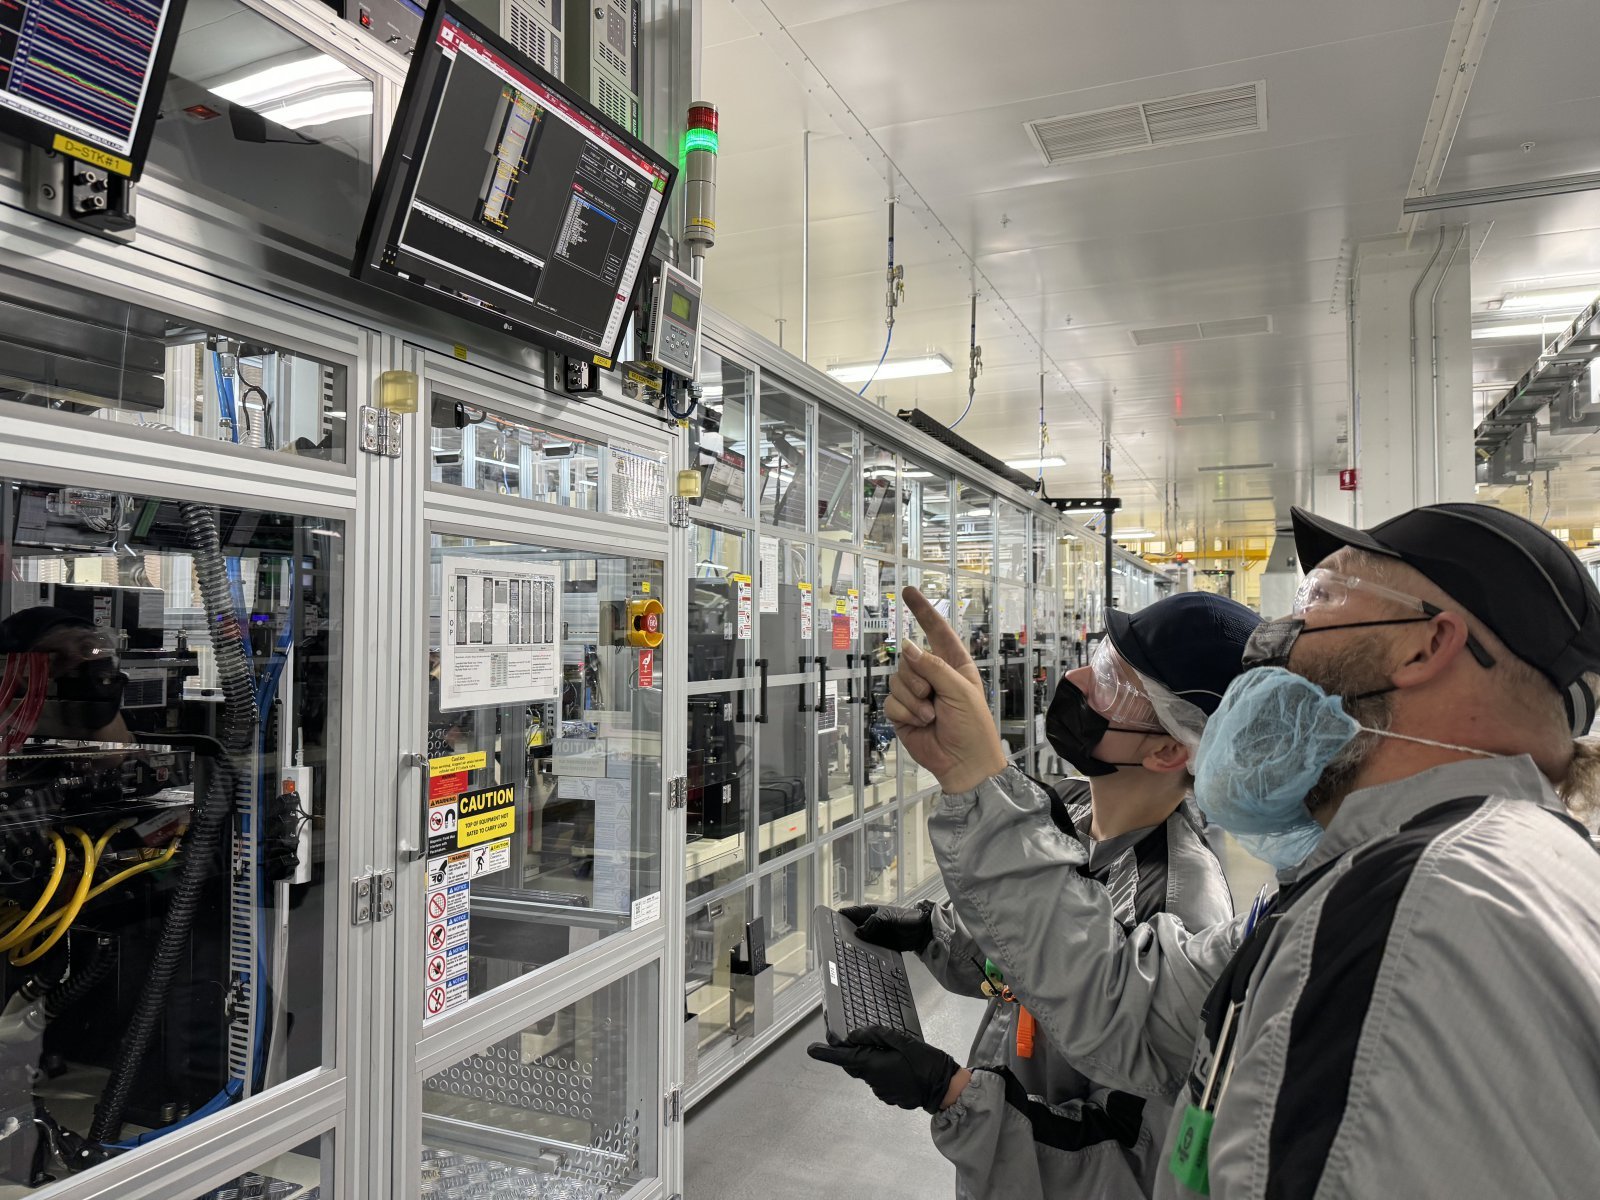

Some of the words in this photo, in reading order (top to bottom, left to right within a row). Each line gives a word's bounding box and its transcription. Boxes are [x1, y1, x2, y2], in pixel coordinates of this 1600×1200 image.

[65, 140, 120, 169] D-STK#1
[435, 796, 457, 806] WARNING
[460, 786, 514, 814] CAUTION
[480, 815, 500, 825] EQUIPMENT
[466, 829, 479, 837] RATED
[485, 824, 497, 833] CARRY
[453, 884, 467, 892] NOTICE
[453, 914, 466, 922] NOTICE
[452, 945, 466, 954] NOTICE
[452, 976, 466, 984] NOTICE
